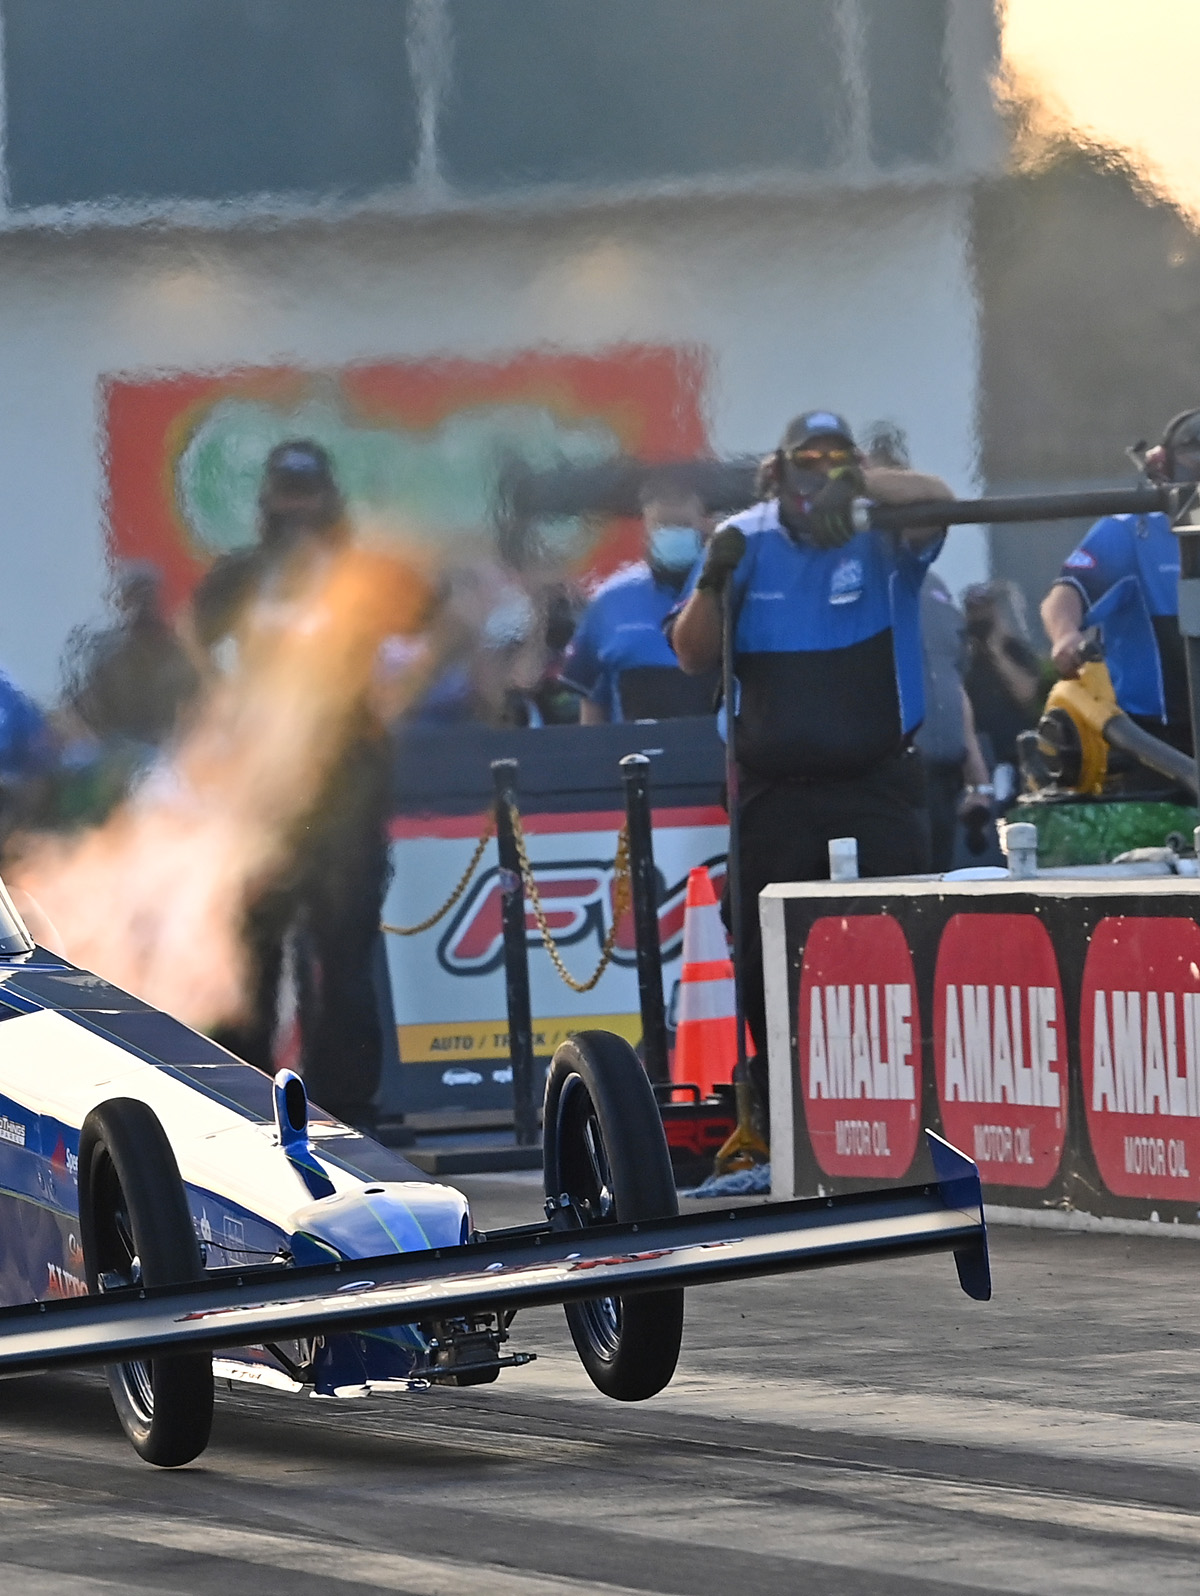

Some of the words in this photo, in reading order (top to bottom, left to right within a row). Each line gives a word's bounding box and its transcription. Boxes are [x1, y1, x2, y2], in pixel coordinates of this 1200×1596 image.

[430, 1036, 473, 1050] AUTO
[494, 1033, 546, 1047] TRK
[809, 984, 915, 1100] AMALIE
[945, 984, 1060, 1108] AMALIE
[1092, 990, 1200, 1117] AMALI
[835, 1120, 871, 1155] MOTOR
[872, 1121, 890, 1156] OIL
[974, 1125, 1013, 1161] MOTOR
[1014, 1127, 1034, 1164] OIL
[1124, 1136, 1166, 1176] MOTOR
[1167, 1138, 1190, 1178] OIL
